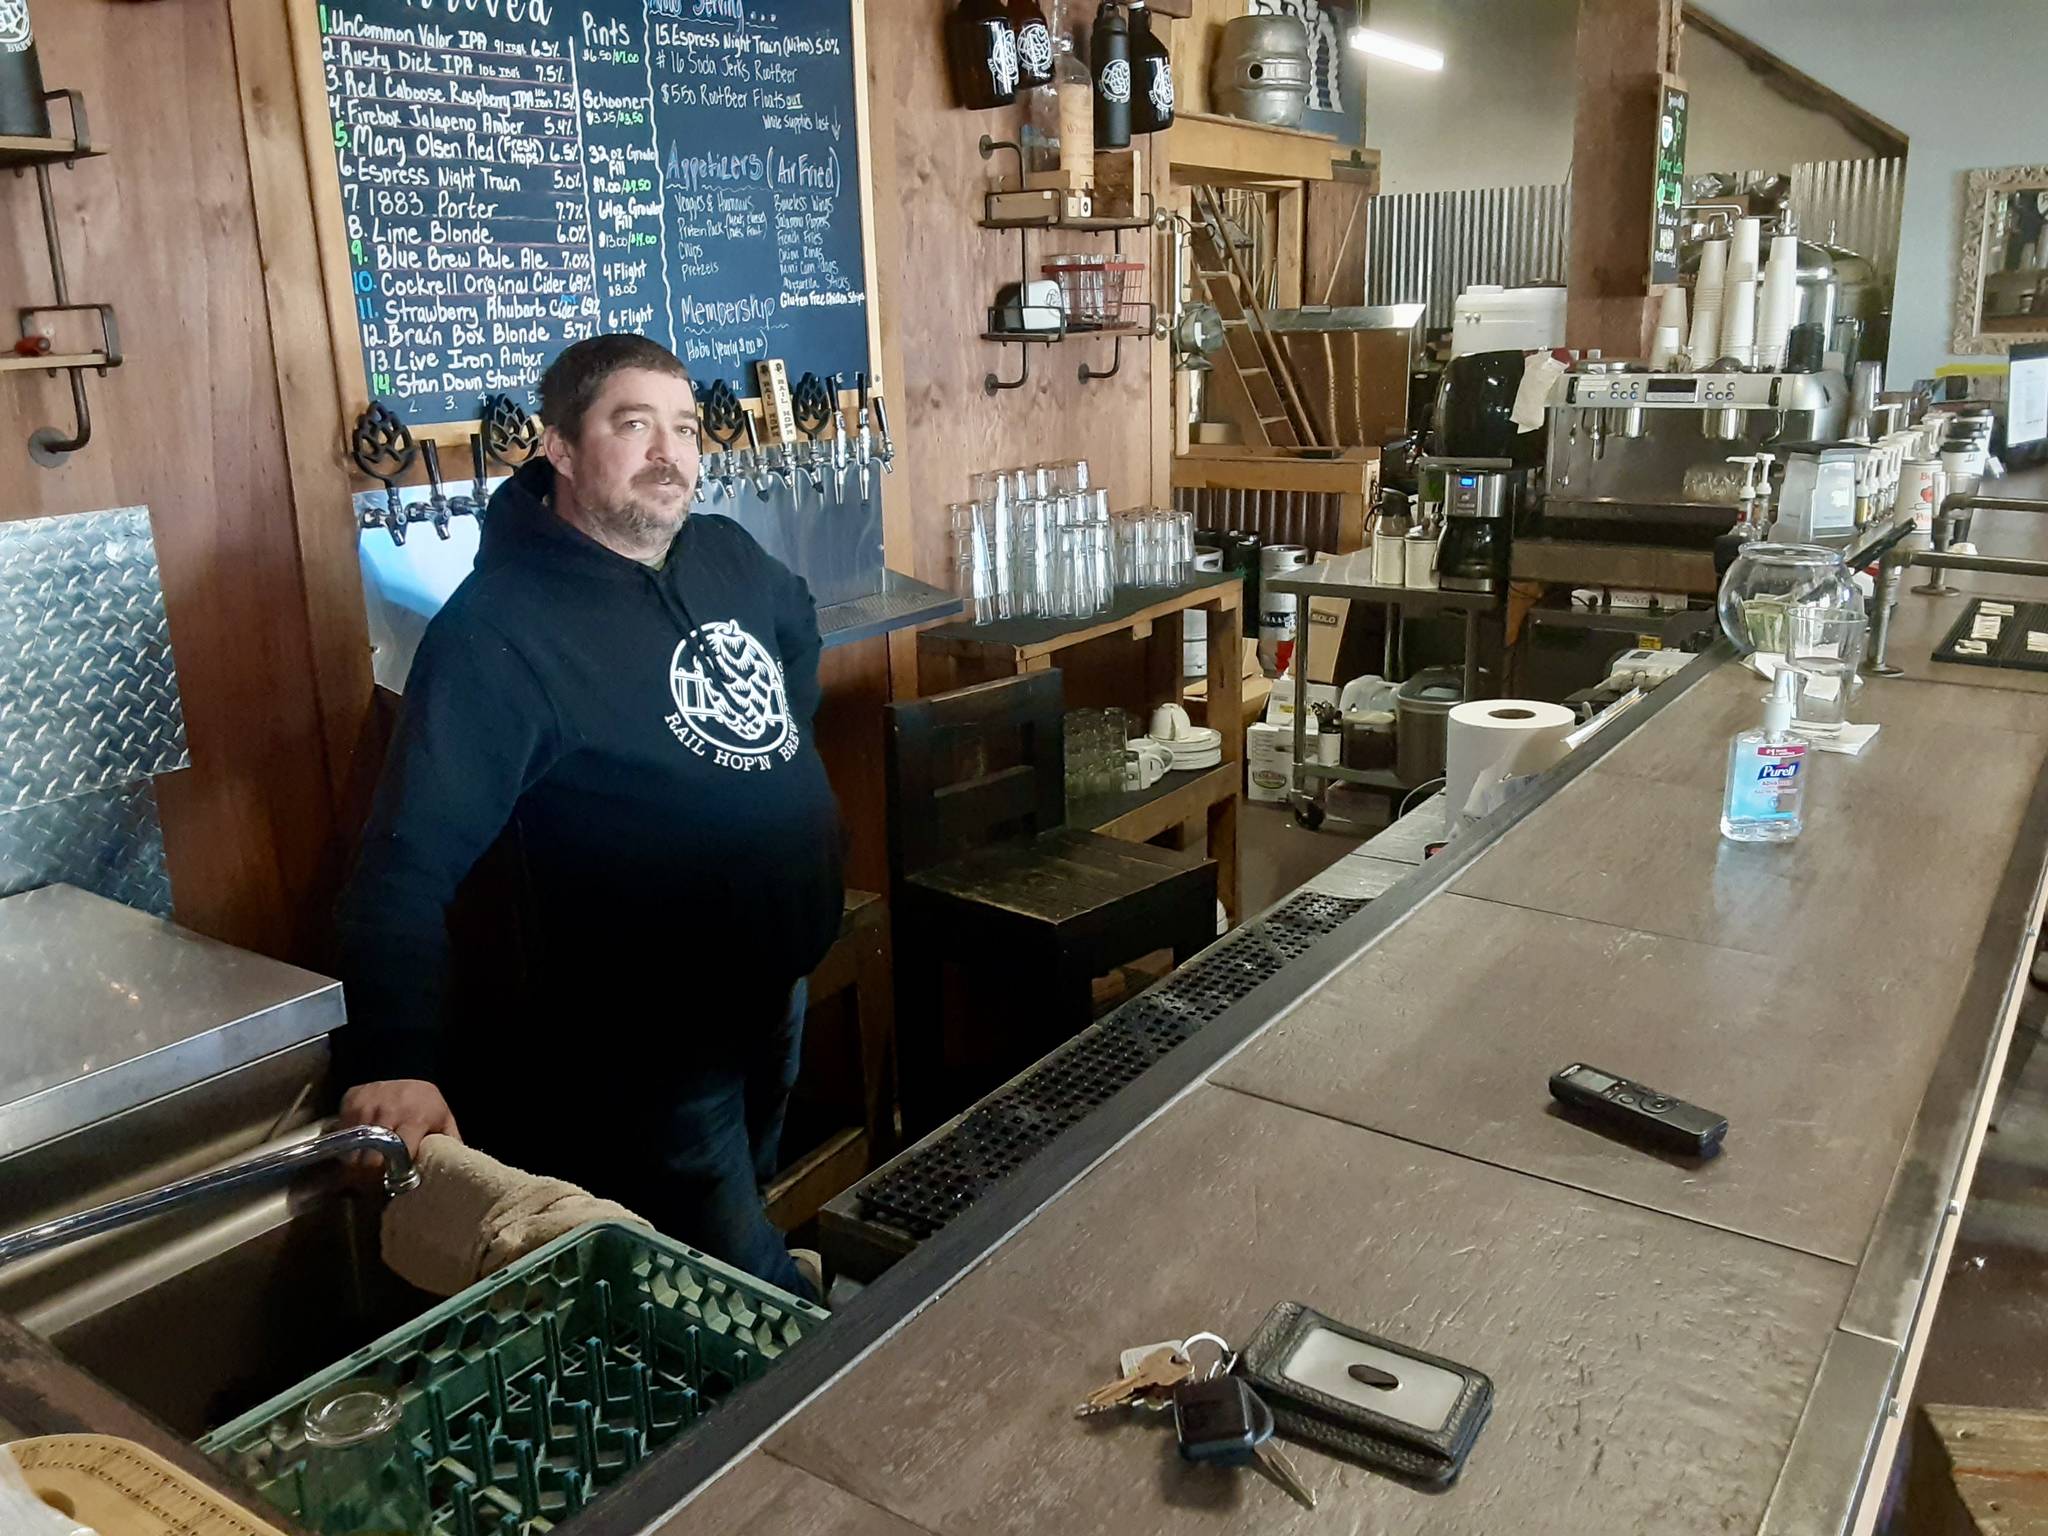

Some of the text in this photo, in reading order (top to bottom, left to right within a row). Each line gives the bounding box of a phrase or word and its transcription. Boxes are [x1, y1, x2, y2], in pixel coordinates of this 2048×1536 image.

[418, 24, 453, 48] Valor
[459, 31, 487, 50] IPA
[582, 11, 630, 47] Pints
[672, 23, 720, 53] Espress
[723, 32, 751, 58] Night
[751, 35, 782, 57] Train
[783, 36, 814, 58] (Nitro)
[341, 41, 390, 74] Rusty
[398, 50, 437, 72] Dick
[441, 55, 472, 75] IPA
[479, 64, 495, 76] 106
[536, 65, 564, 82] 7.5%
[688, 51, 717, 75] Soda
[720, 54, 750, 82] Jerks
[345, 70, 376, 97] Red
[385, 76, 446, 102] Caboose
[450, 81, 511, 117] Raspberry
[511, 90, 534, 108] IPA
[554, 90, 576, 110] 7.5%
[582, 88, 650, 110] Schooner
[753, 87, 786, 110] Floats
[347, 99, 401, 128] Firebox
[409, 105, 476, 134] Jalapeno
[483, 112, 524, 135] Amber
[544, 117, 573, 135] 5.4%
[335, 120, 352, 148] 5.
[353, 124, 406, 167] Mary
[416, 131, 462, 159] Olsen
[467, 132, 494, 162] Red
[550, 142, 579, 161] 6.5%
[340, 148, 582, 193] 6. Espress Night Train 5.0%
[665, 139, 764, 191] Appetizers
[369, 189, 424, 216] 1883
[438, 190, 499, 220] Porter
[555, 201, 584, 221] 7.7%
[348, 215, 587, 245] 8. Lime Blonde 6.0%
[351, 239, 590, 272] 9. Blue Brew Pale Ale 7.0%
[678, 241, 703, 264] Chips
[353, 271, 377, 295] 10.
[381, 271, 458, 297] Cockrell
[463, 275, 529, 299] Original
[532, 271, 567, 294] Cider
[603, 258, 648, 285] 4 Flight
[359, 297, 379, 320] 11.
[384, 295, 480, 329] Strawberry
[486, 294, 548, 321] Rhubarb
[681, 294, 775, 330] Membership
[780, 292, 808, 308] Gluten
[808, 290, 825, 306] Free
[608, 303, 654, 331] 6 Flight
[388, 324, 443, 348] Brain
[452, 323, 486, 347] Box
[493, 319, 550, 345] Blonde
[394, 349, 440, 372] Live
[447, 349, 493, 368] Iron
[500, 345, 545, 368] Amber
[396, 372, 439, 398] Stan
[442, 373, 483, 397] Down
[485, 367, 526, 390] Stout
[664, 712, 772, 771] RAIL HOP'N
[1763, 765, 1796, 778] Purell
